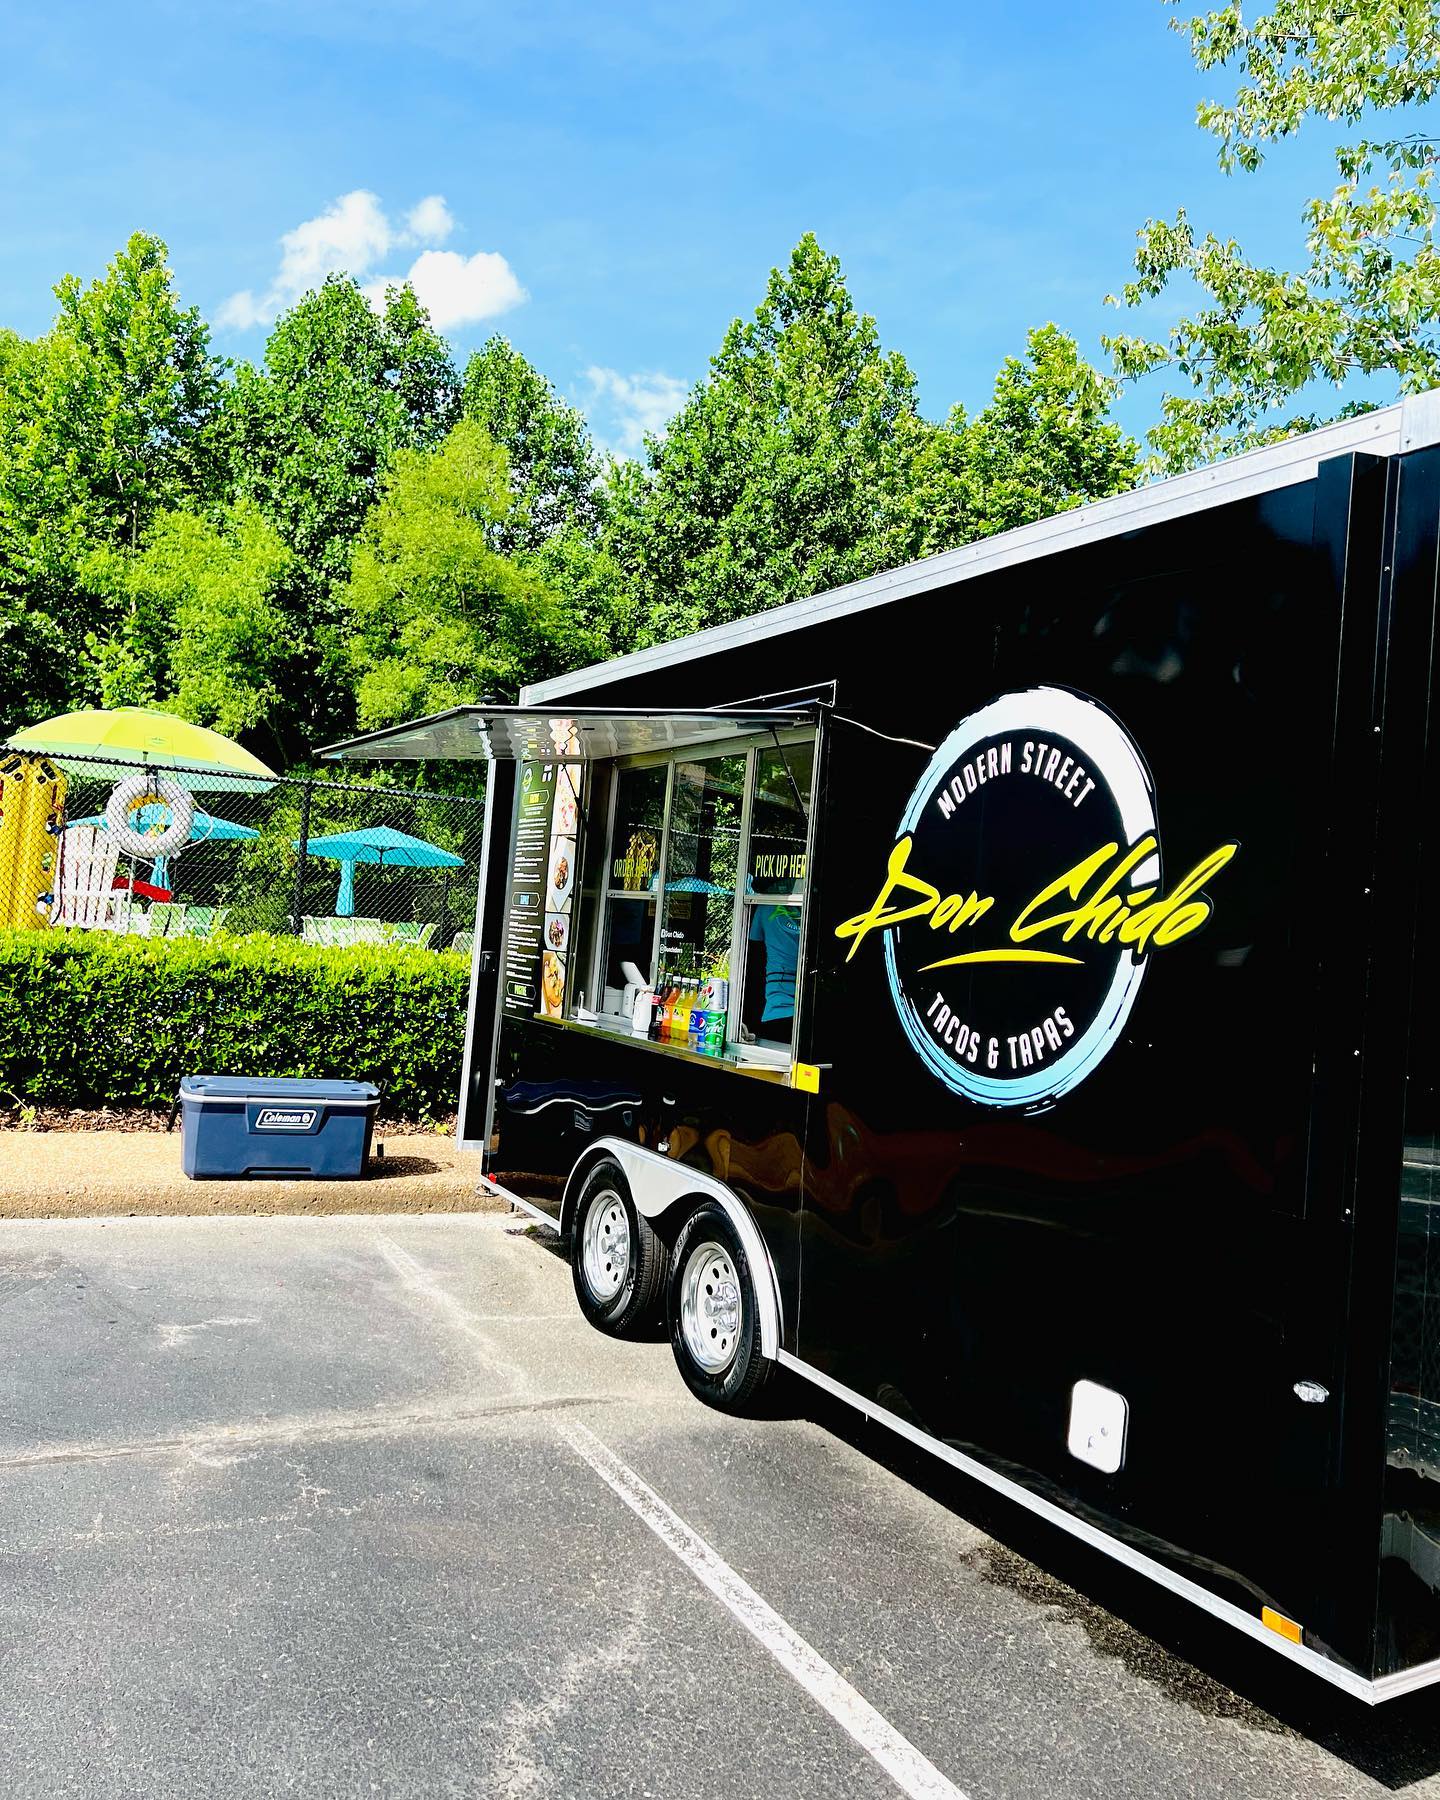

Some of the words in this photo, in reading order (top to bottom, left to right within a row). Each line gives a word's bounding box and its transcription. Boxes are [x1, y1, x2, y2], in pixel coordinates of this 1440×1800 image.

[936, 742, 1013, 820] MODERN
[1020, 741, 1096, 808] STREET
[613, 858, 635, 878] ORDER
[755, 854, 775, 878] PICK
[776, 854, 788, 878] UP
[789, 854, 807, 878] HER
[835, 835, 995, 962] Don
[1009, 835, 1238, 955] Chido
[926, 991, 981, 1063] TACOS
[987, 1038, 999, 1069] &
[1006, 1005, 1075, 1070] TAPAS
[263, 1112, 301, 1123] Coleman
